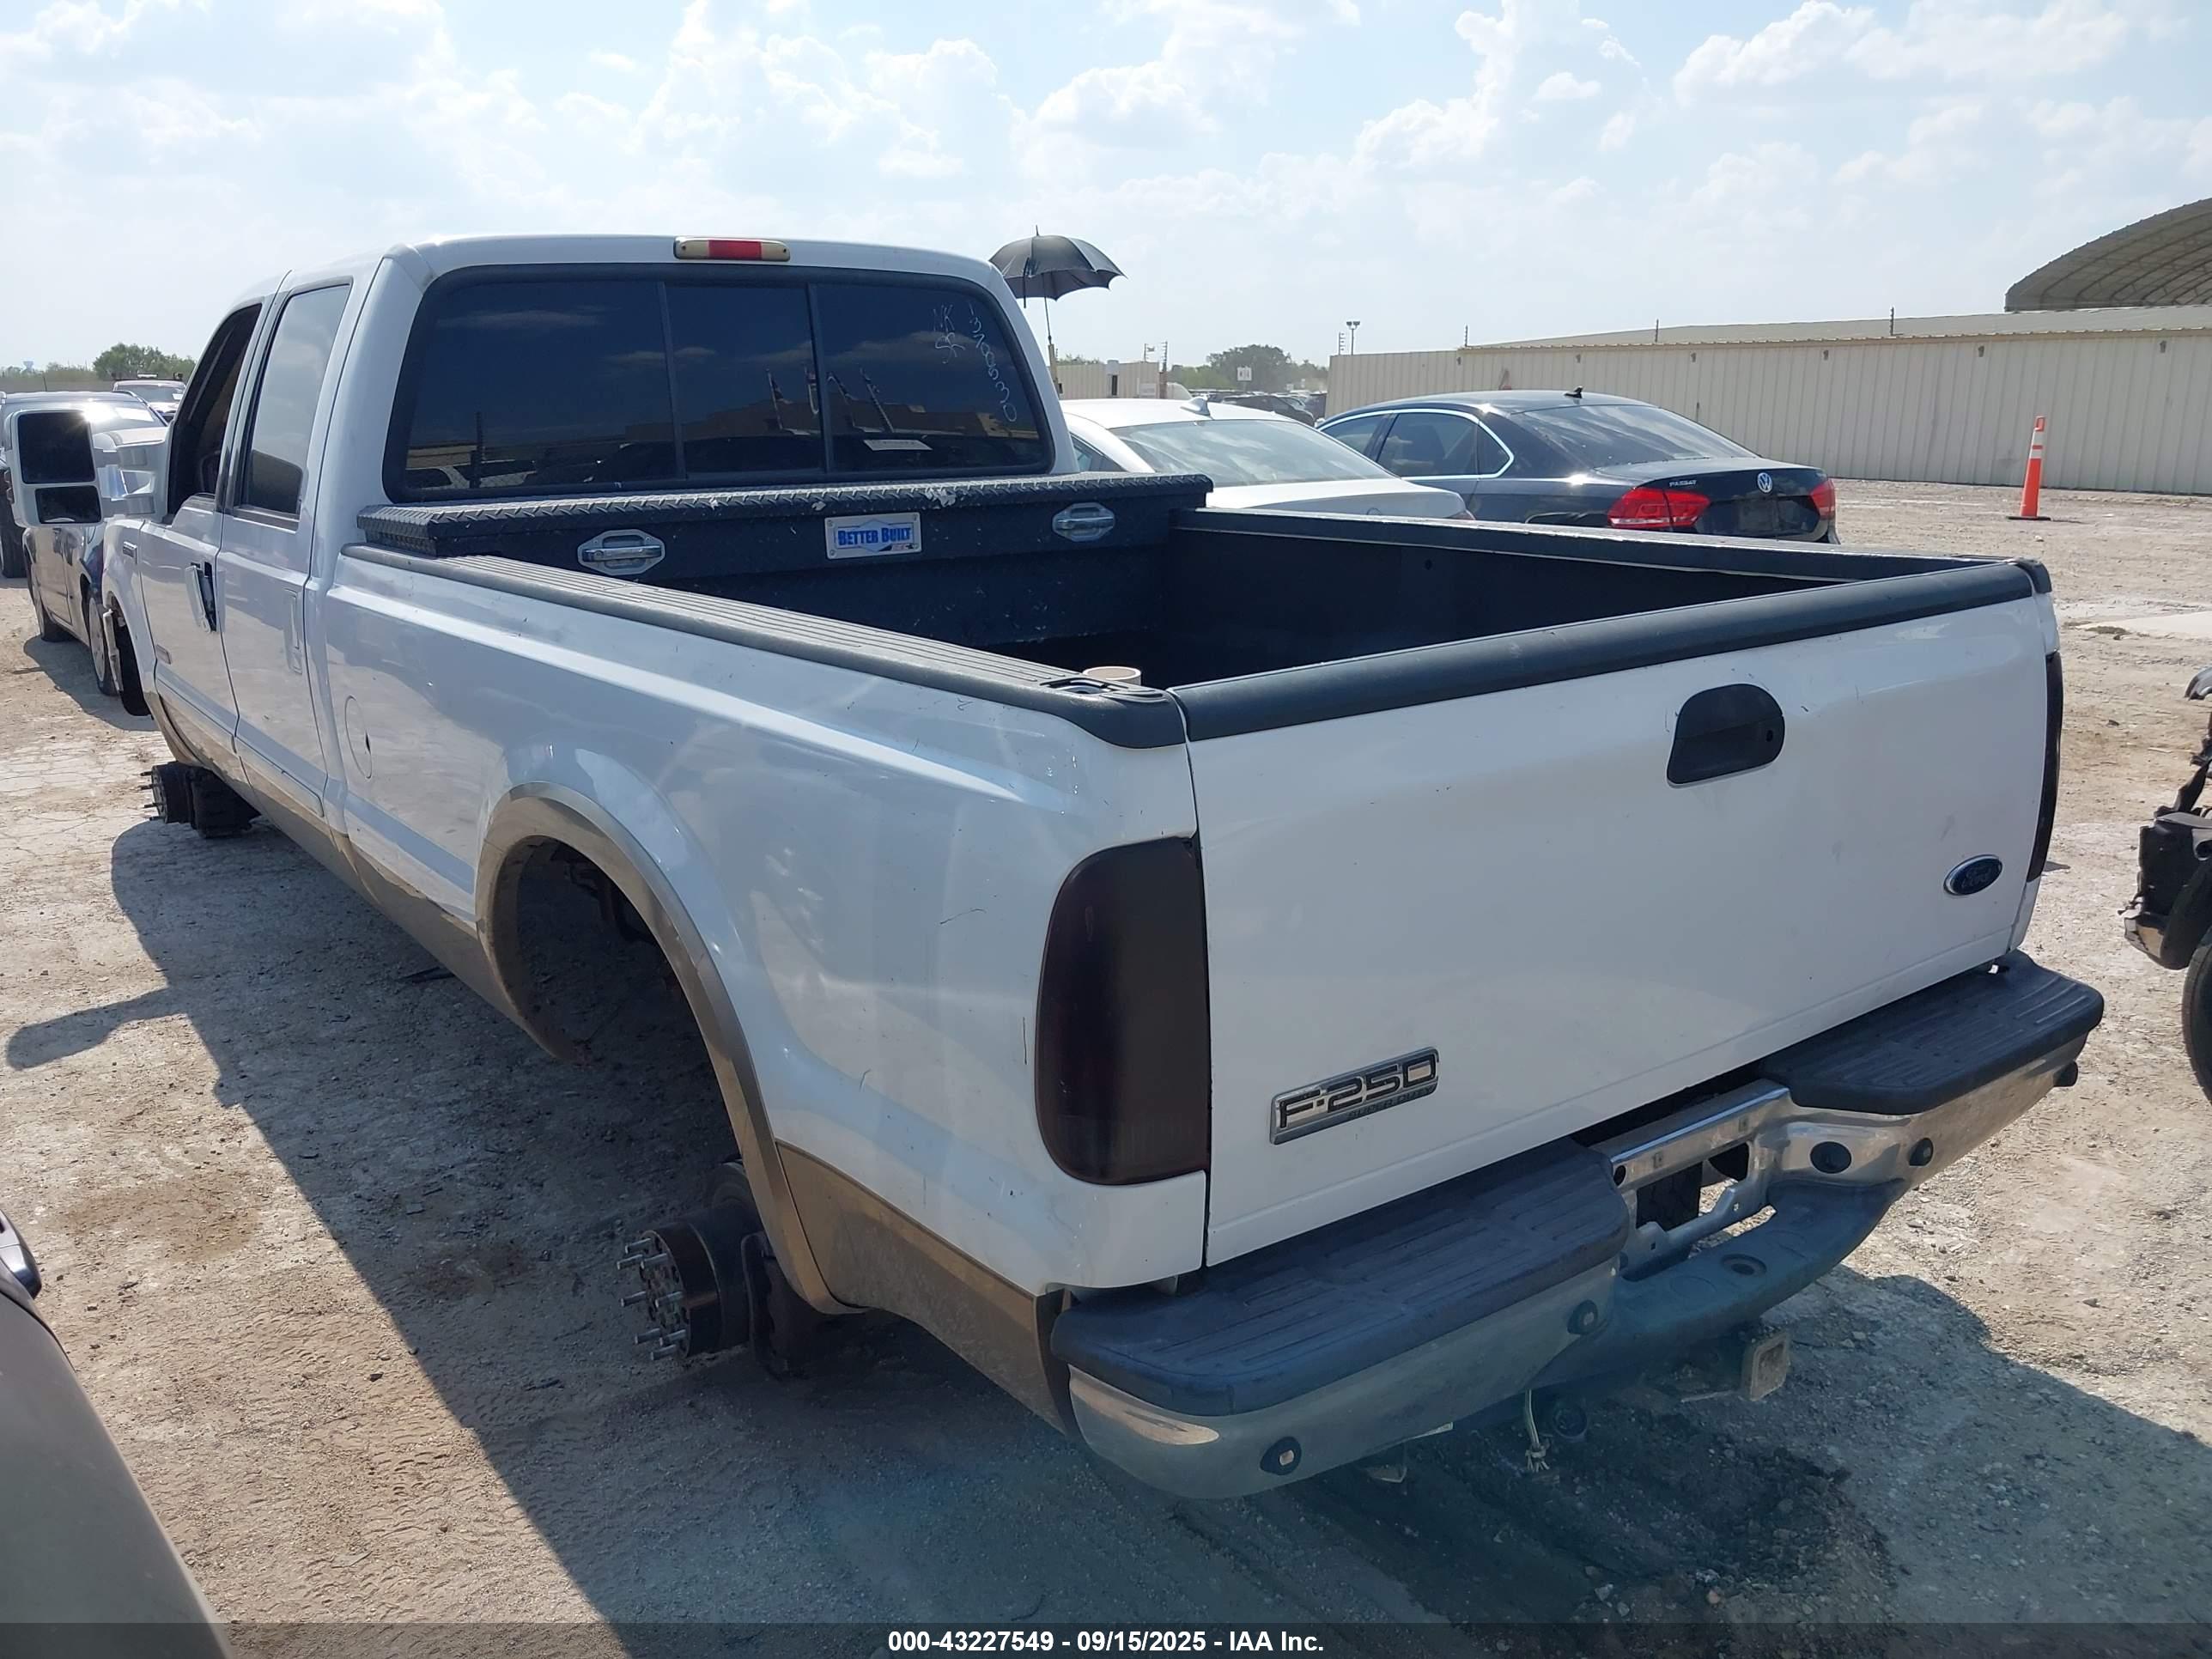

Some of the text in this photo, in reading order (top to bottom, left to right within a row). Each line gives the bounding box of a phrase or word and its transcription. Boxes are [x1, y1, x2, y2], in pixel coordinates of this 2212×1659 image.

[837, 526, 912, 546] BETTER BUILT
[1279, 1054, 1436, 1129] F-250
